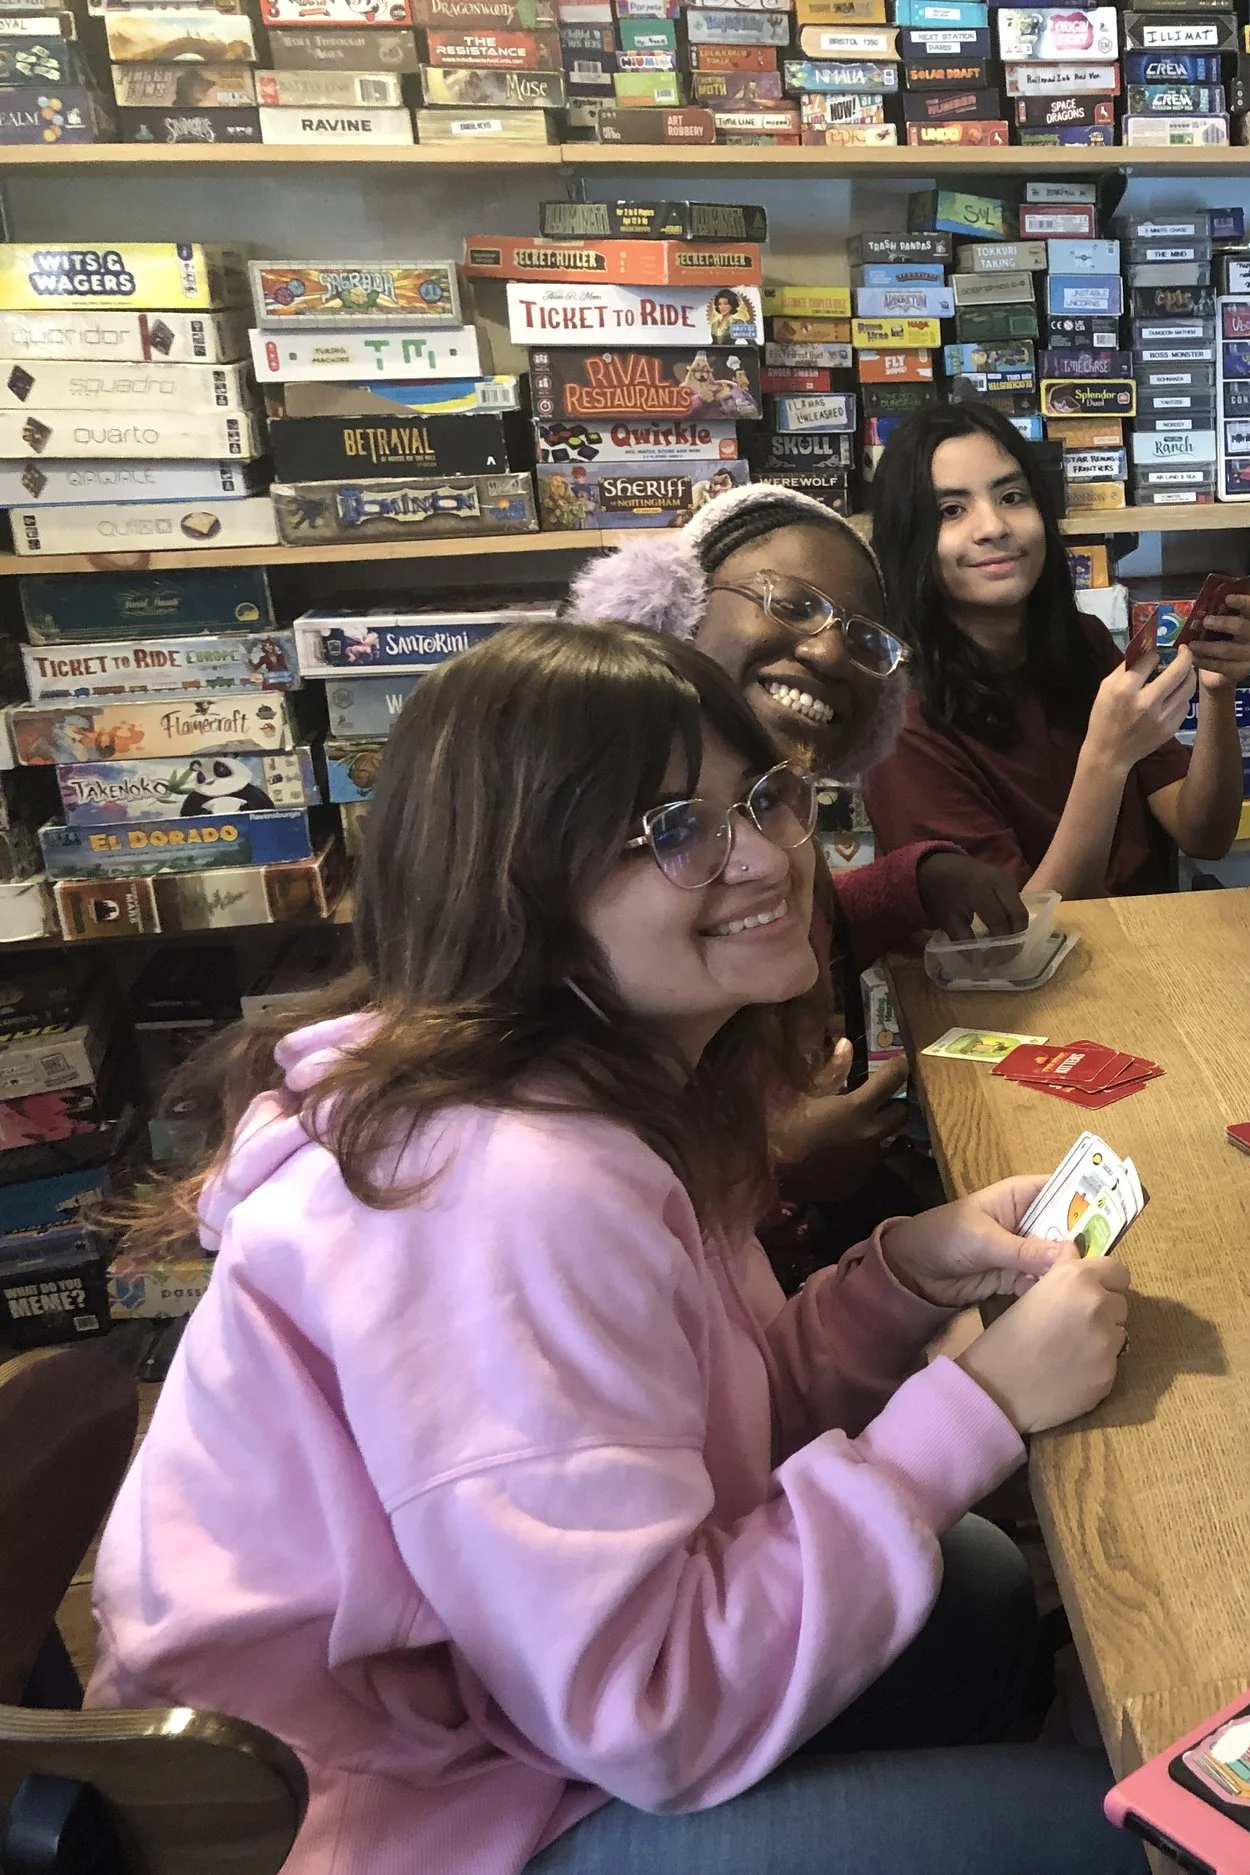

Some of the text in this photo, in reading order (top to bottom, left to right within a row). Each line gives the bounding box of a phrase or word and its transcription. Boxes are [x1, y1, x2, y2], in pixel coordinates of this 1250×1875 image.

[463, 36, 496, 47] THE
[918, 32, 975, 41] NEXT STATION
[1147, 29, 1213, 43] ILLIMAT
[436, 45, 527, 57] RESISTANCE
[946, 67, 981, 79] DRAFT
[1146, 63, 1188, 75] CREW
[505, 73, 548, 101] Muse
[1051, 99, 1077, 112] SPACE
[1152, 93, 1193, 106] CREW
[667, 115, 683, 126] ART
[1046, 107, 1085, 124] DRAGONS
[301, 118, 372, 133] RAVINE
[668, 126, 703, 137] ROBBERY
[868, 239, 932, 252] TRASH PANDAS
[976, 247, 1018, 258] TOKKURI
[37, 252, 122, 272] WITS &
[513, 250, 599, 268] SECRET HITLER
[675, 252, 746, 266] SECRET HITLER
[980, 257, 1016, 268] TAKING
[32, 274, 133, 292] WAGERS
[319, 272, 398, 304] SAGRADA
[519, 298, 696, 329] TICKET TO RIDE
[885, 355, 906, 368] FLY
[584, 352, 671, 389] RIVAL
[565, 384, 693, 412] RESTAURANTS
[1075, 387, 1117, 403] Splendor
[611, 421, 713, 448] Qwirkle
[343, 427, 435, 464] BETRAYAL
[771, 436, 833, 455] SKULL
[1155, 436, 1196, 455] Ranch
[65, 468, 156, 487] QAWALE
[617, 498, 681, 508] NOTTINGHAM
[33, 655, 107, 679] TICKET
[112, 656, 130, 669] TO
[133, 648, 182, 669] RIDE
[161, 709, 250, 739] Flamecraft
[70, 777, 170, 803] TAKENOKO
[89, 825, 240, 852] EL DORADO
[4, 1278, 83, 1300] WHAT DO YOU
[8, 1289, 86, 1319] MEME?
